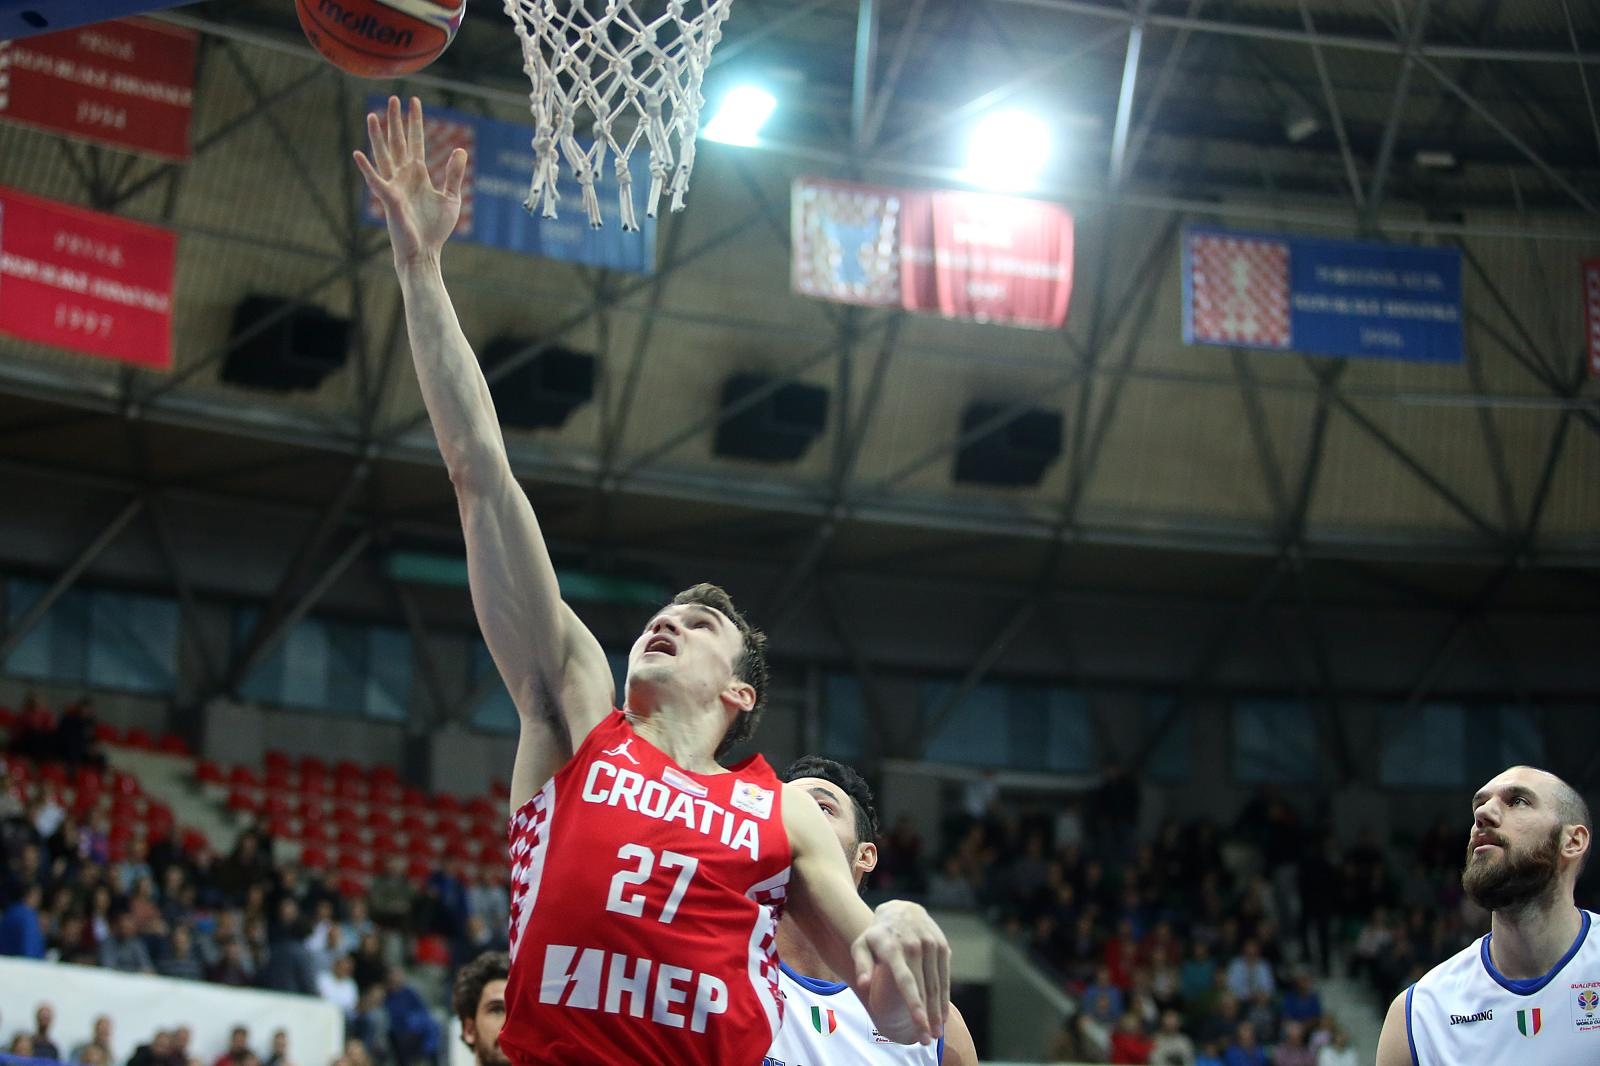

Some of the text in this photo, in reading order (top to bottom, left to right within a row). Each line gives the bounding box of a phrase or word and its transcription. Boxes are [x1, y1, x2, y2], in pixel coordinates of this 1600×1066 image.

[319, 0, 413, 47] molten
[582, 760, 760, 862] CROATIA
[606, 842, 699, 924] 27
[604, 952, 728, 1034] HEP
[1450, 1009, 1493, 1026] SPALDING
